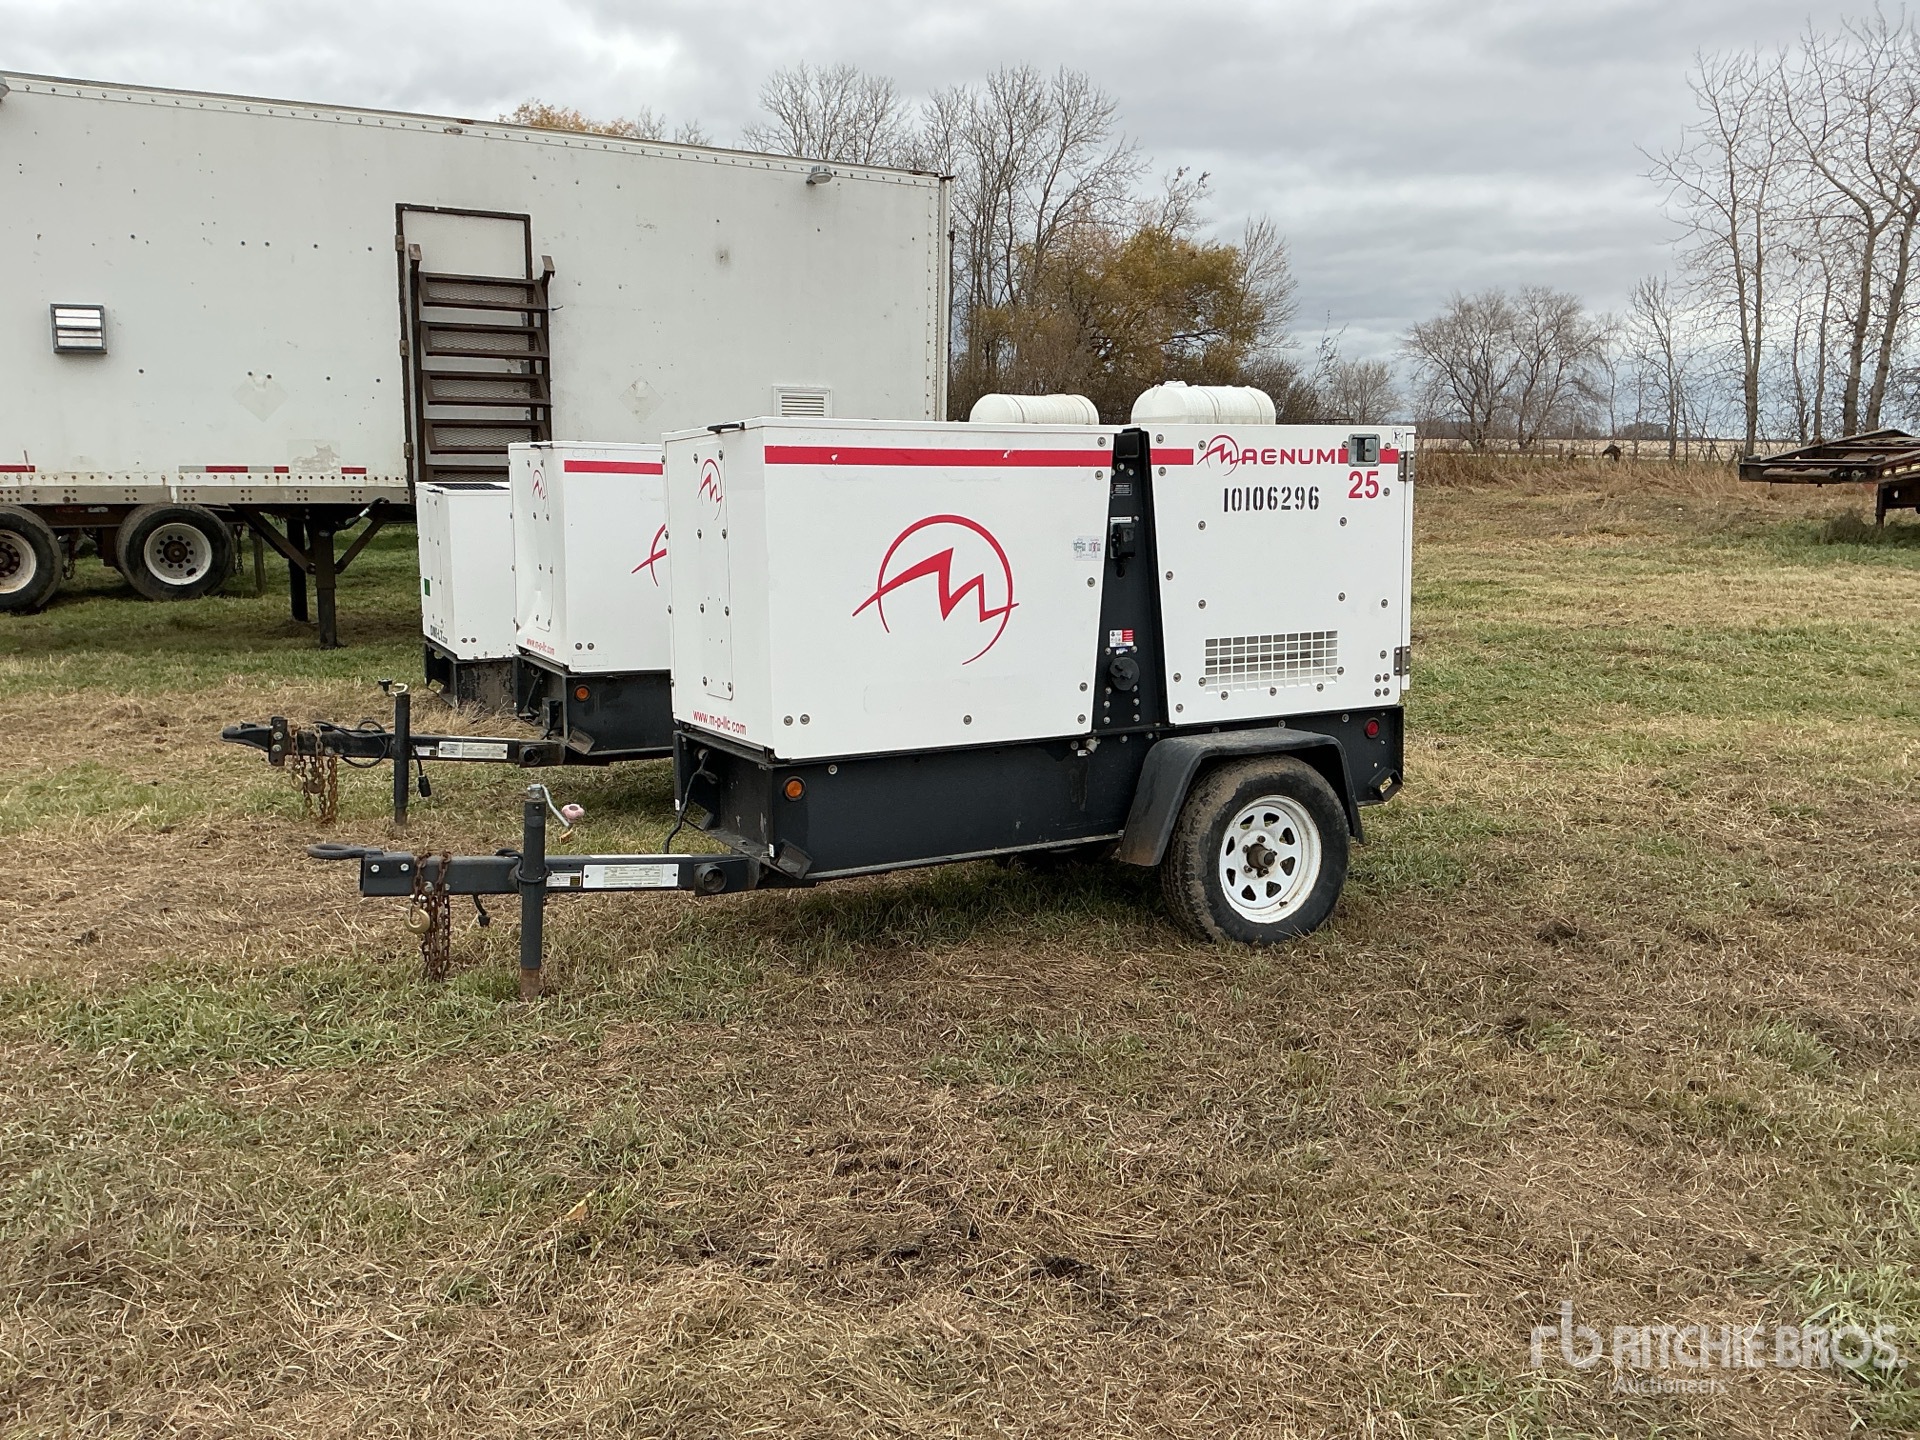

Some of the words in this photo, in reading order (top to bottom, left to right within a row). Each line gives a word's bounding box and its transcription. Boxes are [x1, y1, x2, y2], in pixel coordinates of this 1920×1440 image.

[1196, 434, 1336, 476] MAGNUM
[1223, 485, 1320, 513] 10106296
[1347, 470, 1380, 499] 25
